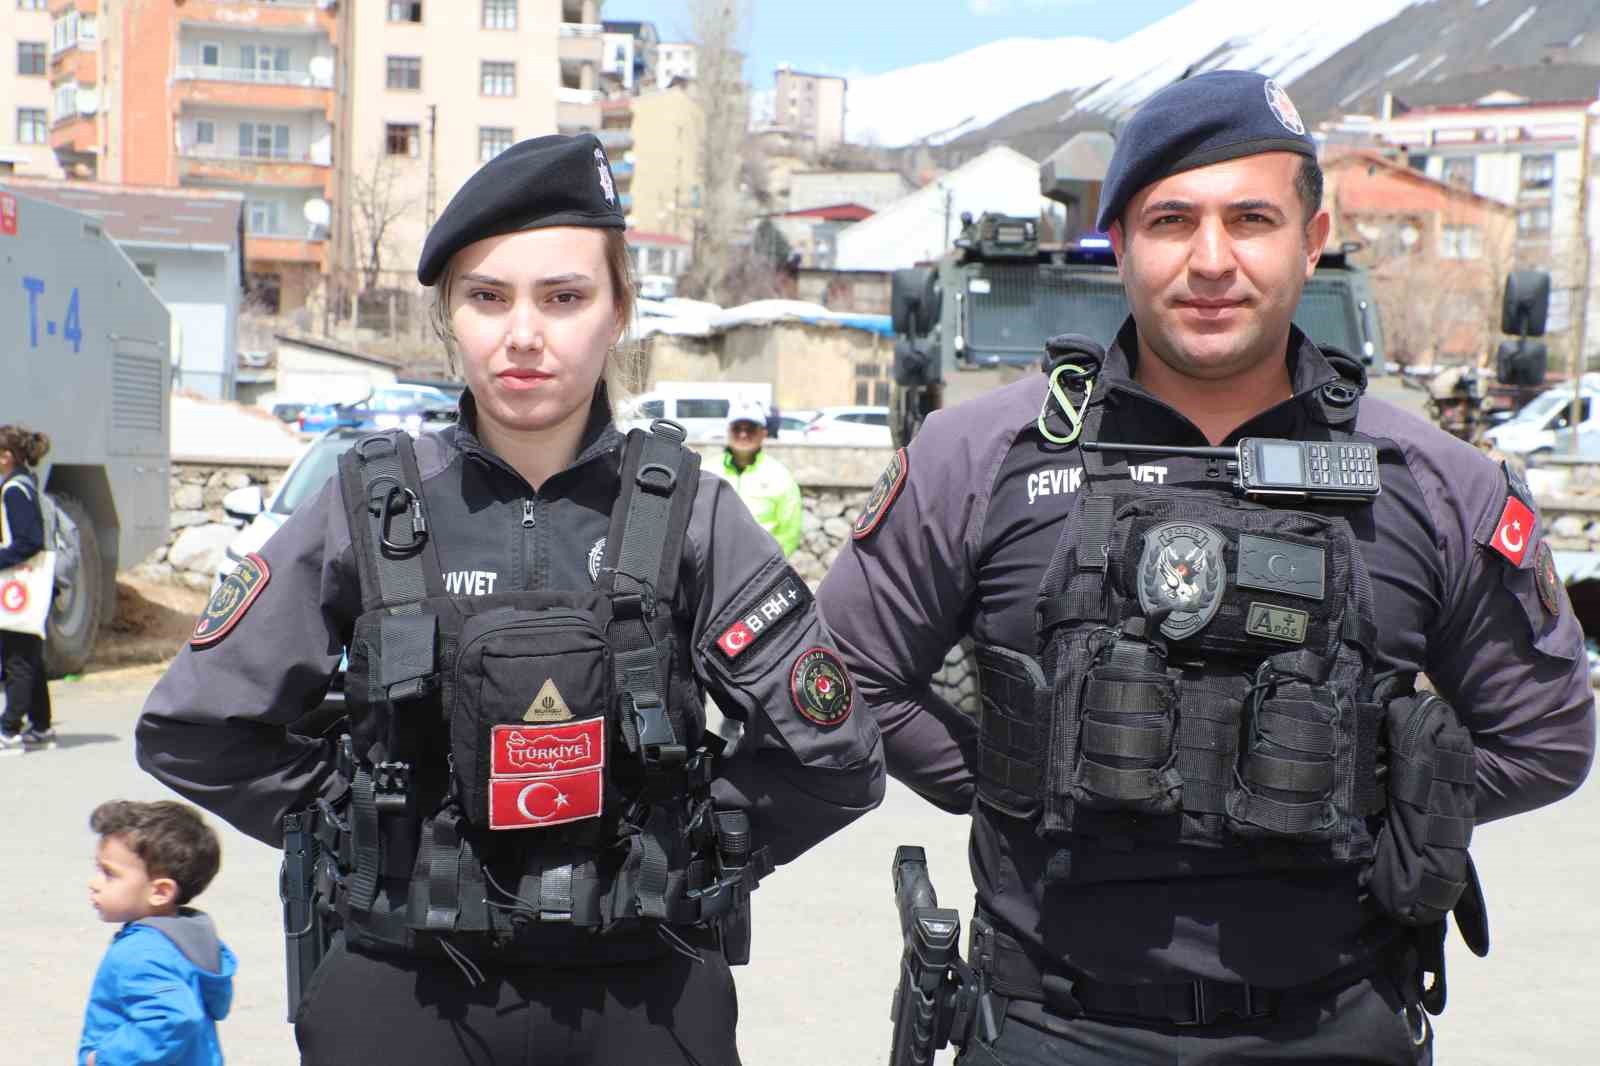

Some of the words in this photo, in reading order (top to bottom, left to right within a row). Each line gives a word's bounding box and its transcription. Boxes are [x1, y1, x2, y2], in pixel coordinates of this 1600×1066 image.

[22, 276, 81, 353] T-4
[1127, 465, 1168, 485] VET
[744, 614, 765, 633] B
[514, 743, 585, 762] TÜRKİYE
